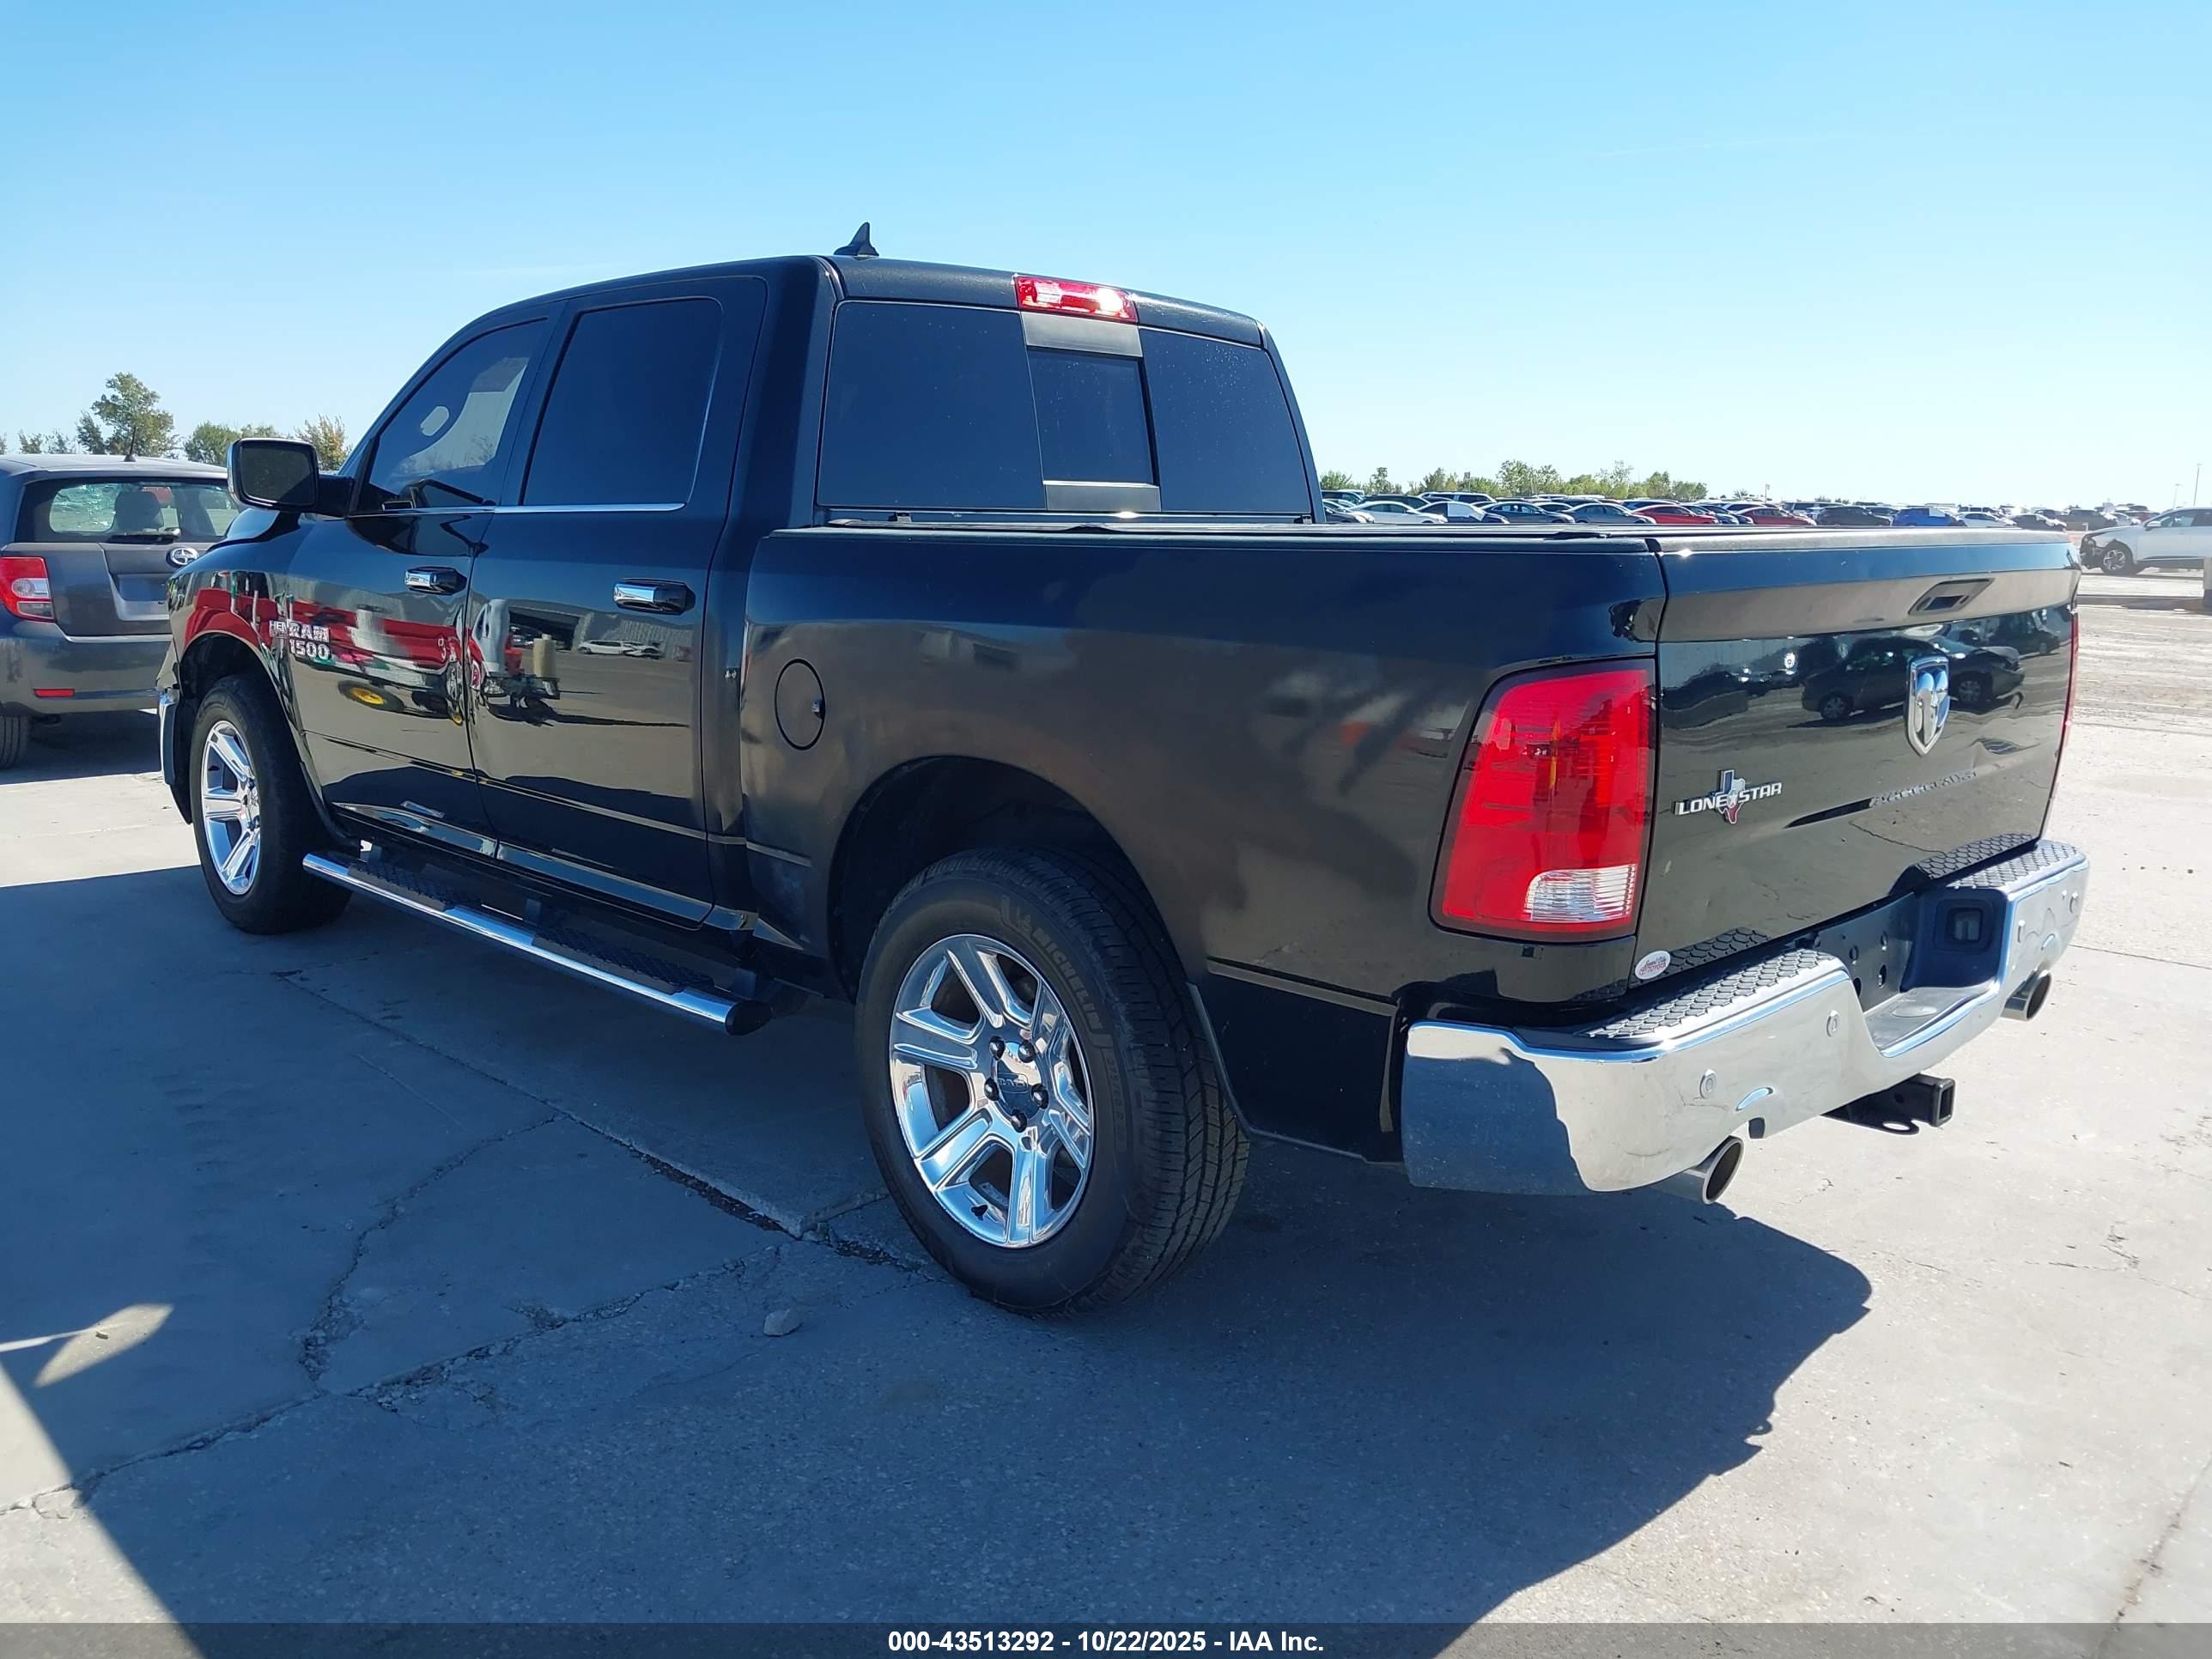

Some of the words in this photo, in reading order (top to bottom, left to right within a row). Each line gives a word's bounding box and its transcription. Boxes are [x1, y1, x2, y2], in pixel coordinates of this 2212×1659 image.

[287, 619, 330, 642] RAM
[289, 639, 331, 659] 1500
[1676, 794, 1729, 815] LONE
[1738, 782, 1783, 804] STAR
[1033, 927, 1103, 1029] MICHELIN
